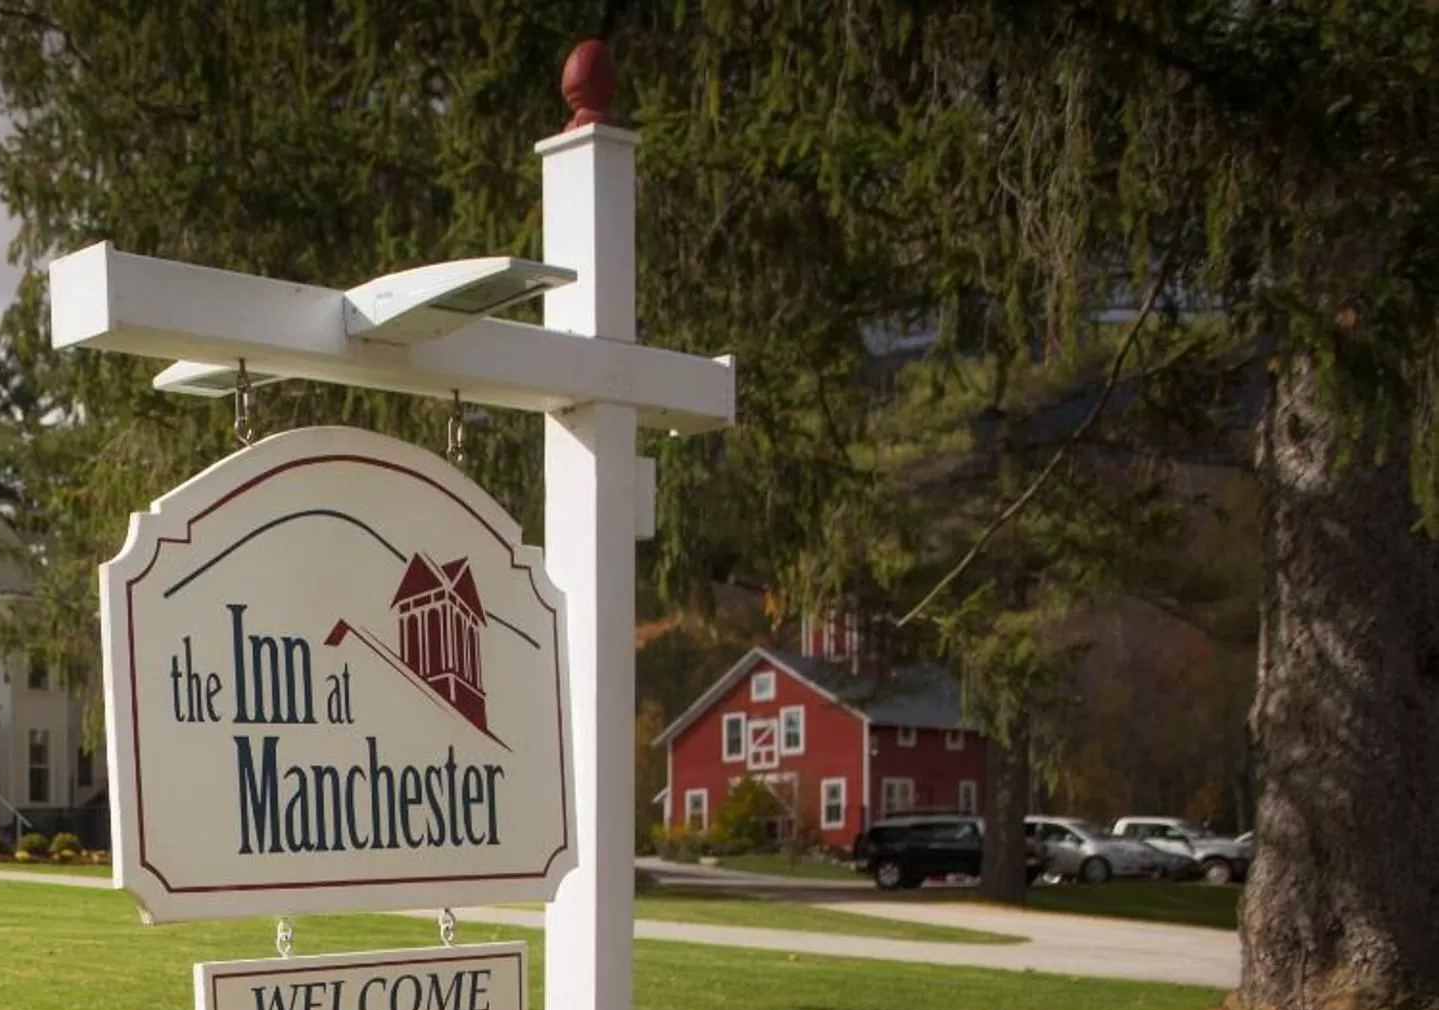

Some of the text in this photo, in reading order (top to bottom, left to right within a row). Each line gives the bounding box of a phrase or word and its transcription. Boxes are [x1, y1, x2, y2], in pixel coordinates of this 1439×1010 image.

[170, 603, 355, 724] the Inn at
[233, 736, 505, 855] Manchester
